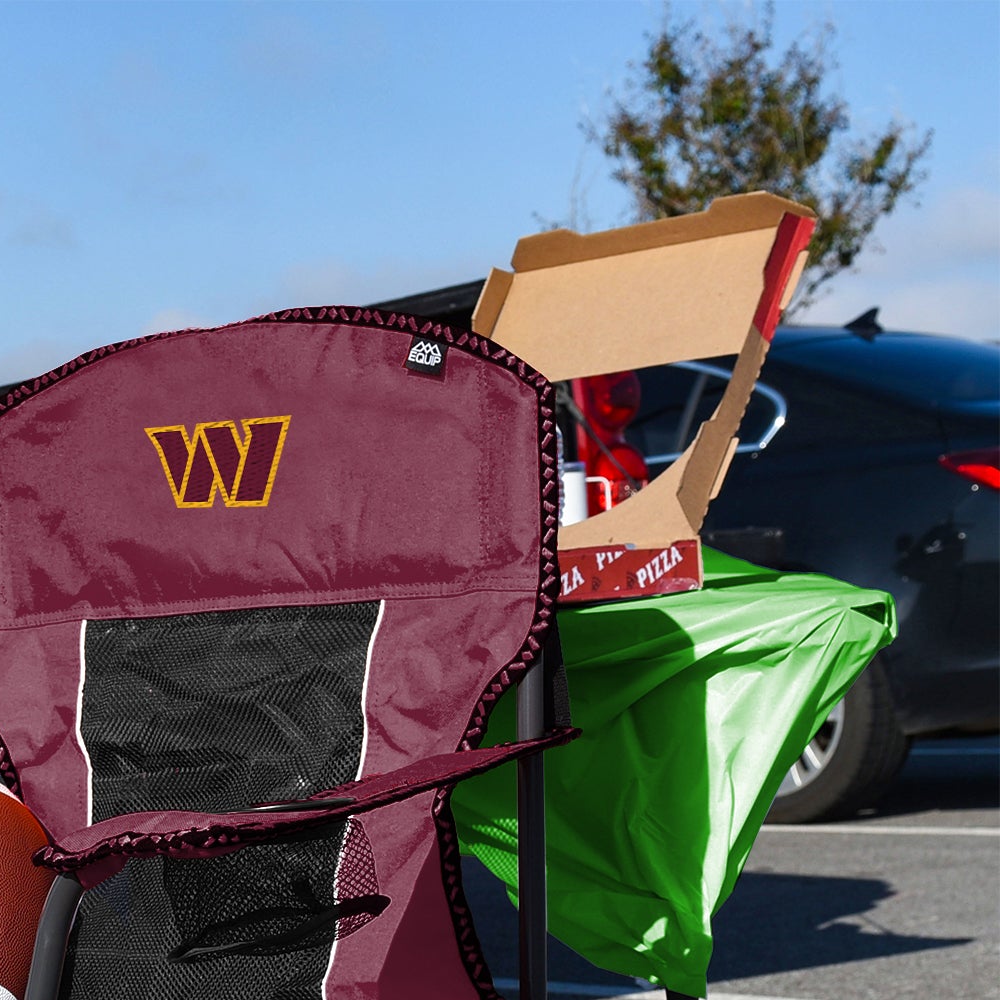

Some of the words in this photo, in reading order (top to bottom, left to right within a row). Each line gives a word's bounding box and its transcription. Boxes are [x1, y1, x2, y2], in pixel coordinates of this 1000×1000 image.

[408, 350, 441, 366] EQUIP
[144, 415, 292, 508] W
[636, 546, 683, 588] PIZZA
